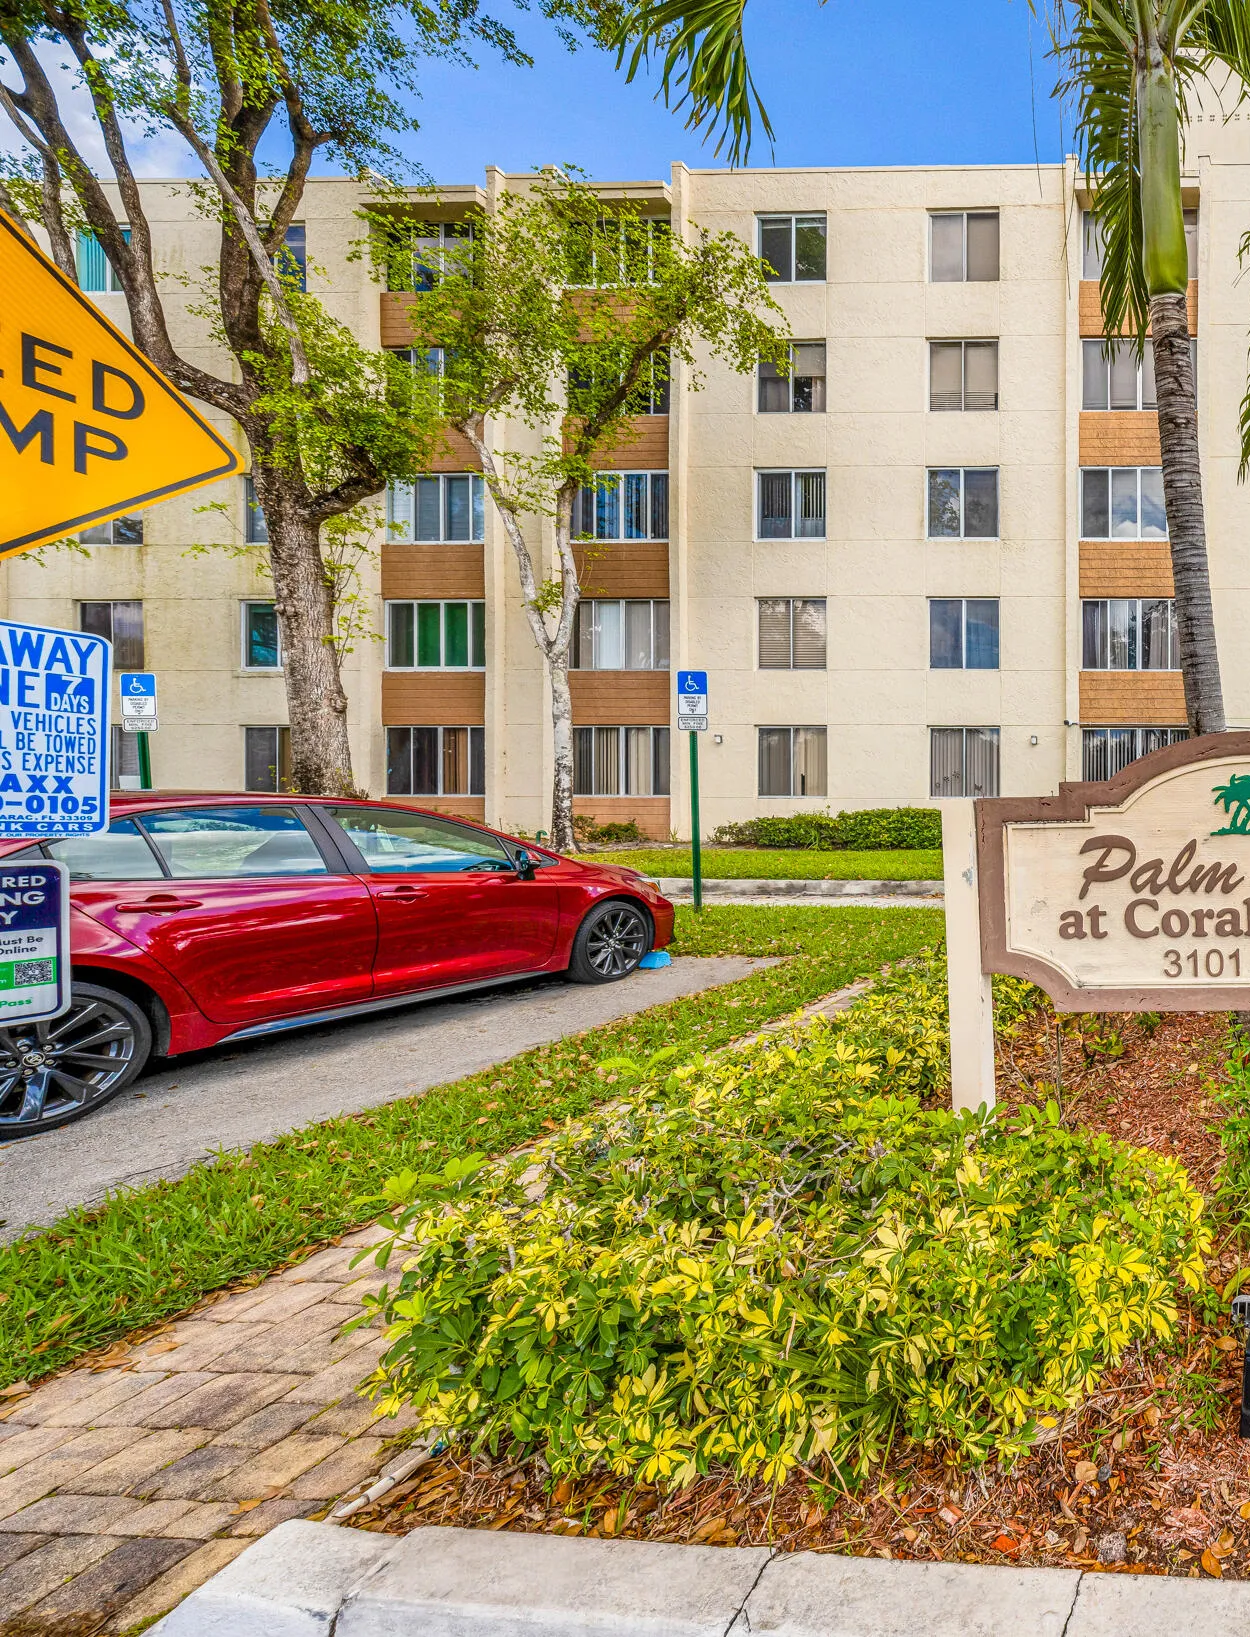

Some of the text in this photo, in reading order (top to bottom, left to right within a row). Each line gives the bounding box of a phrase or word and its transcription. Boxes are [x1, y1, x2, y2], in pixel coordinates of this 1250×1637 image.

[0, 332, 146, 421] ED
[61, 675, 82, 695] 7
[50, 692, 89, 713] DAYS
[10, 711, 96, 736] VEHICLES
[16, 731, 36, 751] BE
[45, 734, 96, 755] TOWED
[22, 752, 96, 774] EXPENSE
[0, 794, 98, 814] -0105
[36, 823, 93, 831] CARS
[1079, 834, 1245, 900] Palm
[2, 875, 46, 888] RED
[1059, 903, 1108, 940] at
[27, 935, 43, 943] Be
[1164, 948, 1241, 978] 3101
